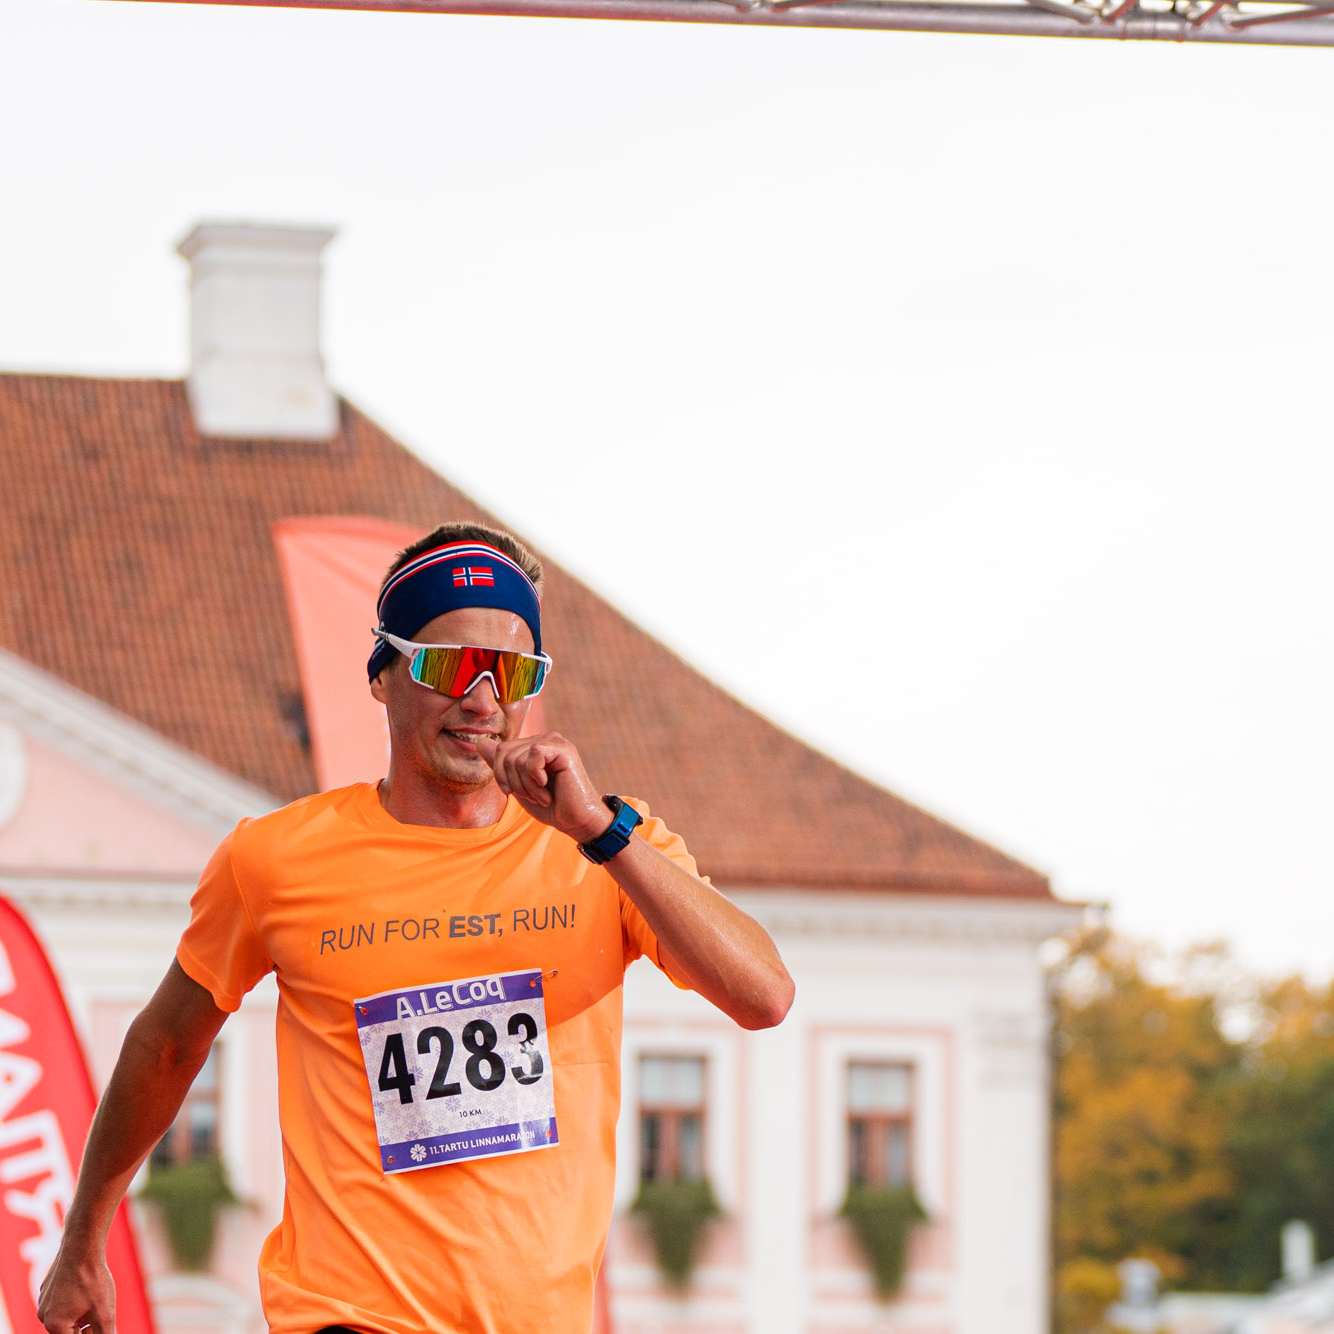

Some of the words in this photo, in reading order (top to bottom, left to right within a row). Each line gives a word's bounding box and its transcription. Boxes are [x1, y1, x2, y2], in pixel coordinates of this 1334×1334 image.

[320, 923, 375, 956] RUN
[384, 918, 440, 942] FOR
[449, 913, 503, 938] EST,
[513, 904, 576, 932] RUN!
[377, 1012, 544, 1105] 4283
[459, 1110, 468, 1119] 10
[469, 1108, 482, 1117] KM
[471, 1130, 535, 1149] LINNAMARAON
